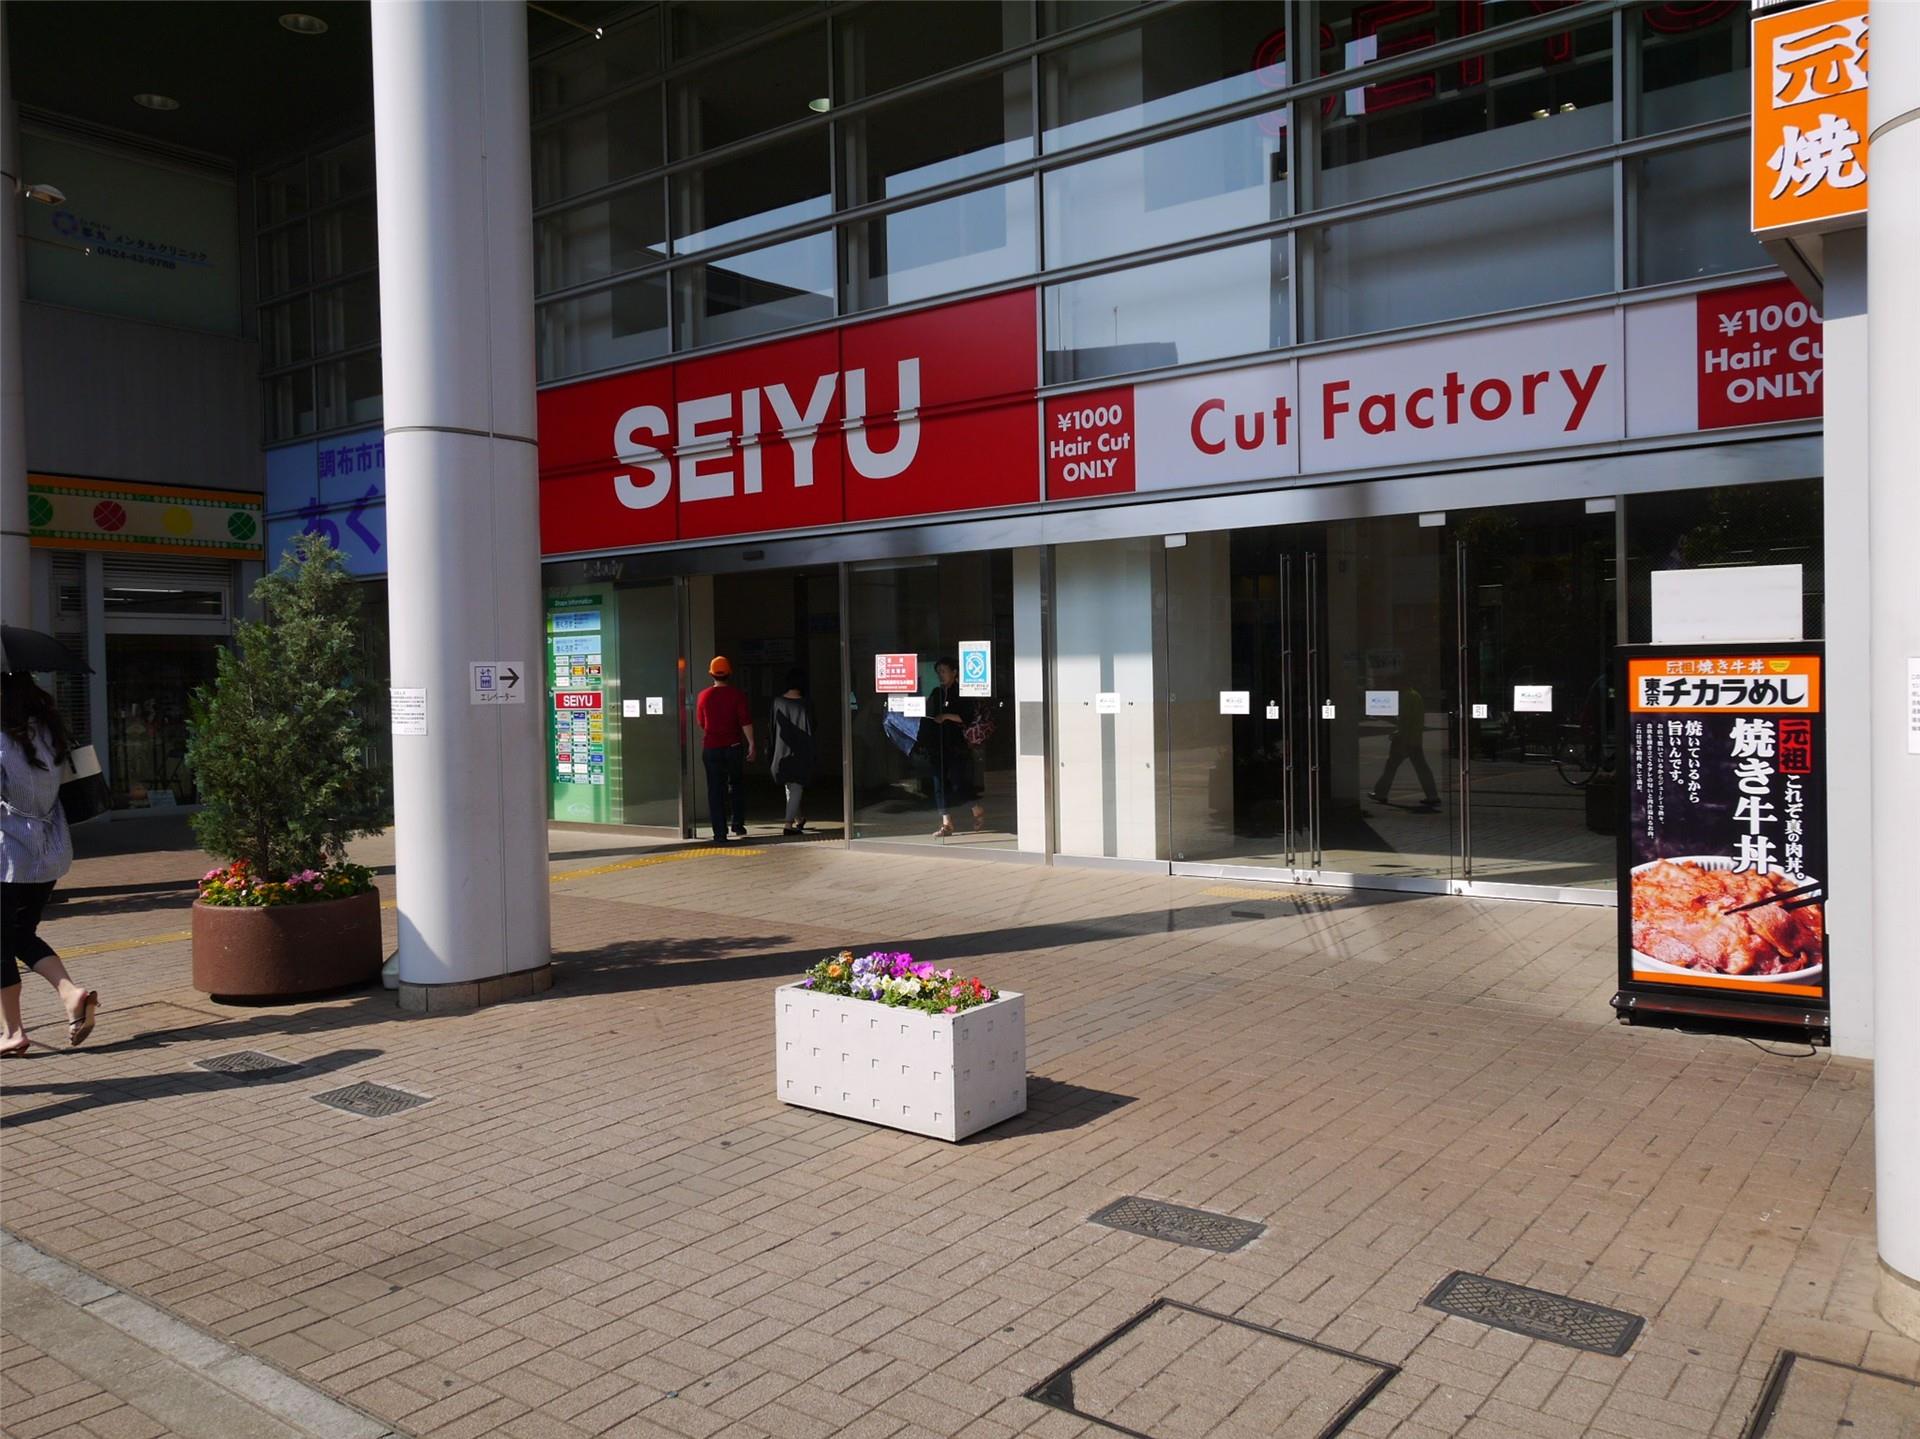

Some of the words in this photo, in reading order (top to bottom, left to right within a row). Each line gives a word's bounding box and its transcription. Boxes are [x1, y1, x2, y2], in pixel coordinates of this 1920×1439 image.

[1776, 16, 1868, 103] 元
[1766, 113, 1867, 200] 焼
[1705, 342, 1776, 374] Hair
[1727, 369, 1823, 403] ONLY
[612, 357, 920, 510] SEIYU
[1057, 404, 1123, 432] ¥1000
[1191, 395, 1291, 455] Cut
[1322, 364, 1607, 440] Factory
[1050, 436, 1091, 459] Hair
[1098, 432, 1130, 452] Cut
[1063, 458, 1118, 482] ONLY
[563, 694, 593, 707] SEIYU
[1645, 678, 1661, 706] 東京
[1663, 677, 1805, 706] チカラめし
[1668, 720, 1684, 785] 旨いんです。
[1685, 720, 1704, 803] 焼いているから
[1780, 720, 1810, 771] 元祖
[1729, 718, 1778, 875] 焼き牛丼
[1784, 774, 1805, 880] これぞ真の肉丼。
